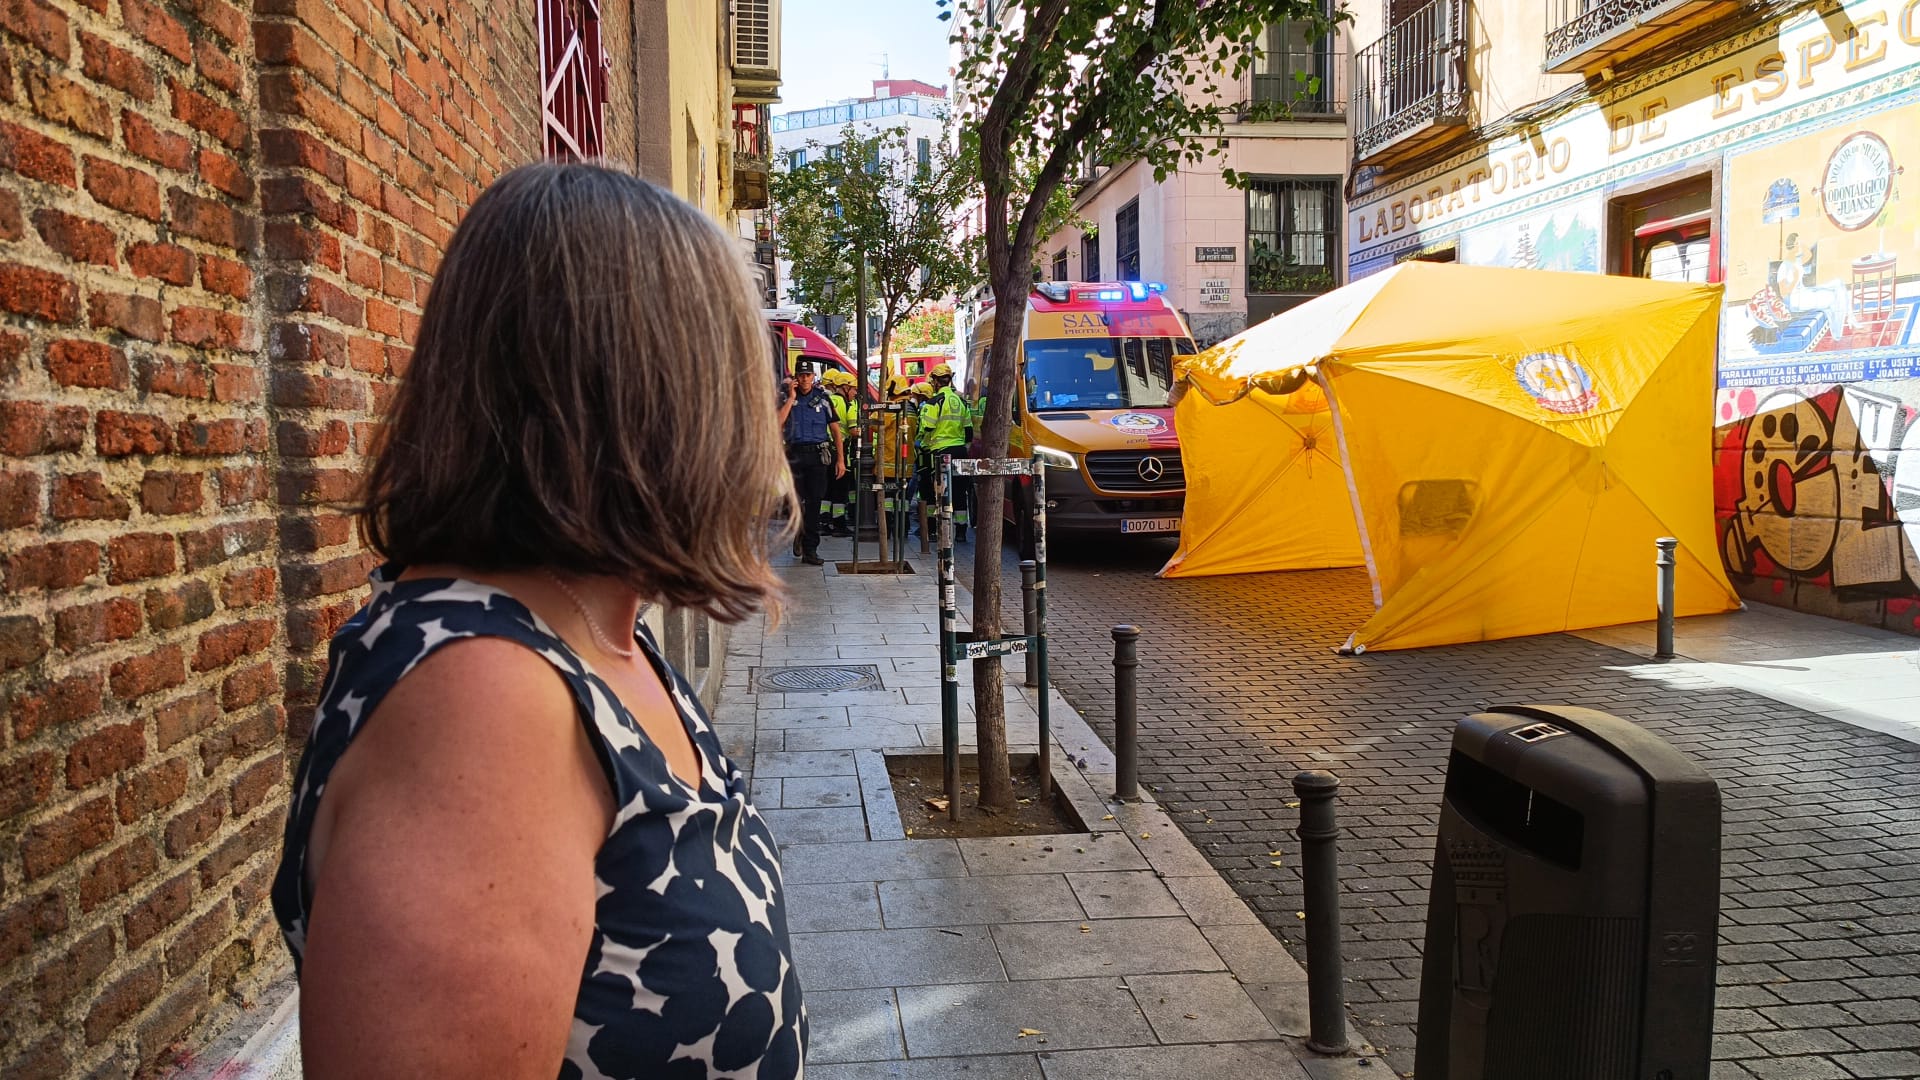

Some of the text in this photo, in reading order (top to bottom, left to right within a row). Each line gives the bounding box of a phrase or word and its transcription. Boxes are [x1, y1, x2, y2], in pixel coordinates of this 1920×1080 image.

[1359, 136, 1571, 243] LABORATORIO
[1609, 96, 1668, 155] DE
[1830, 147, 1852, 184] DOLOR
[1063, 312, 1154, 329] SAMUR
[1721, 370, 1740, 379] PARA
[1741, 370, 1751, 378] LA
[1752, 367, 1784, 377] LIMPIEZA
[1786, 366, 1796, 375] DE
[1798, 364, 1819, 374] BOCA
[1822, 364, 1830, 372] Y
[1830, 361, 1864, 372] DIENTES
[1891, 357, 1913, 367] USEN
[1726, 377, 1767, 386] PERBORATO
[1769, 376, 1779, 385] DE
[1780, 375, 1802, 384] SOSA
[1805, 371, 1863, 382] AROMATIZADO
[1128, 520, 1177, 531] 0070 LJT
